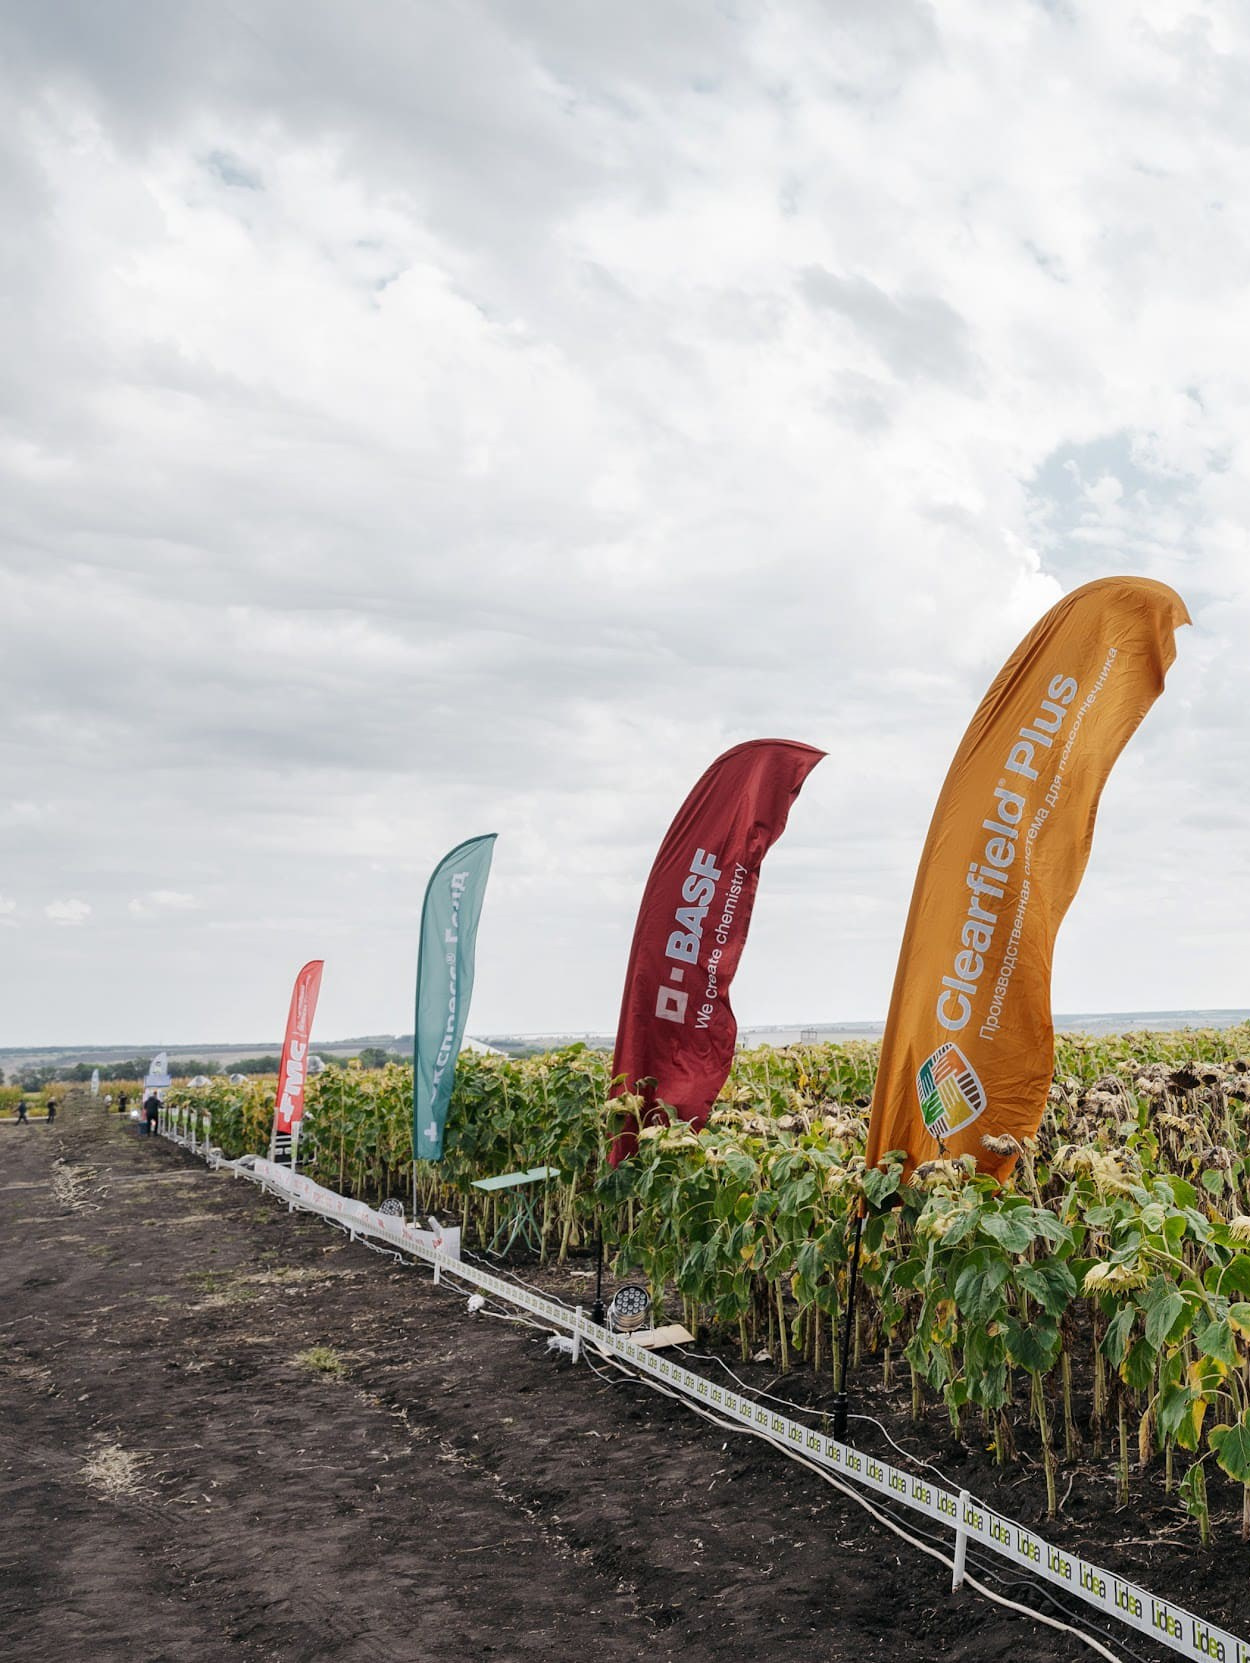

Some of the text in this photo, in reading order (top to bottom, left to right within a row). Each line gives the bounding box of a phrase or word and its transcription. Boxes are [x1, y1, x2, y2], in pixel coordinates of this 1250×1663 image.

[1003, 672, 1080, 783] Plus
[665, 847, 723, 965] BASF
[979, 647, 1119, 1042] Производственная система для подсолнечника
[694, 862, 748, 1030] We create chemistry
[279, 1039, 306, 1123] FMC
[846, 1448, 861, 1471] Lidea
[866, 1457, 883, 1482] Lidea
[889, 1467, 906, 1493] Lidea
[912, 1478, 931, 1505] Lidea
[937, 1488, 957, 1517] Lidea
[963, 1502, 983, 1531] Lidea
[989, 1516, 1011, 1546] Lidea
[1017, 1530, 1041, 1562] Lidea
[1048, 1546, 1071, 1580] Lidea
[1079, 1562, 1106, 1599] Lidea
[1114, 1580, 1142, 1619] Lidea
[1152, 1599, 1182, 1640] Lidea
[1192, 1620, 1225, 1661] Lidea
